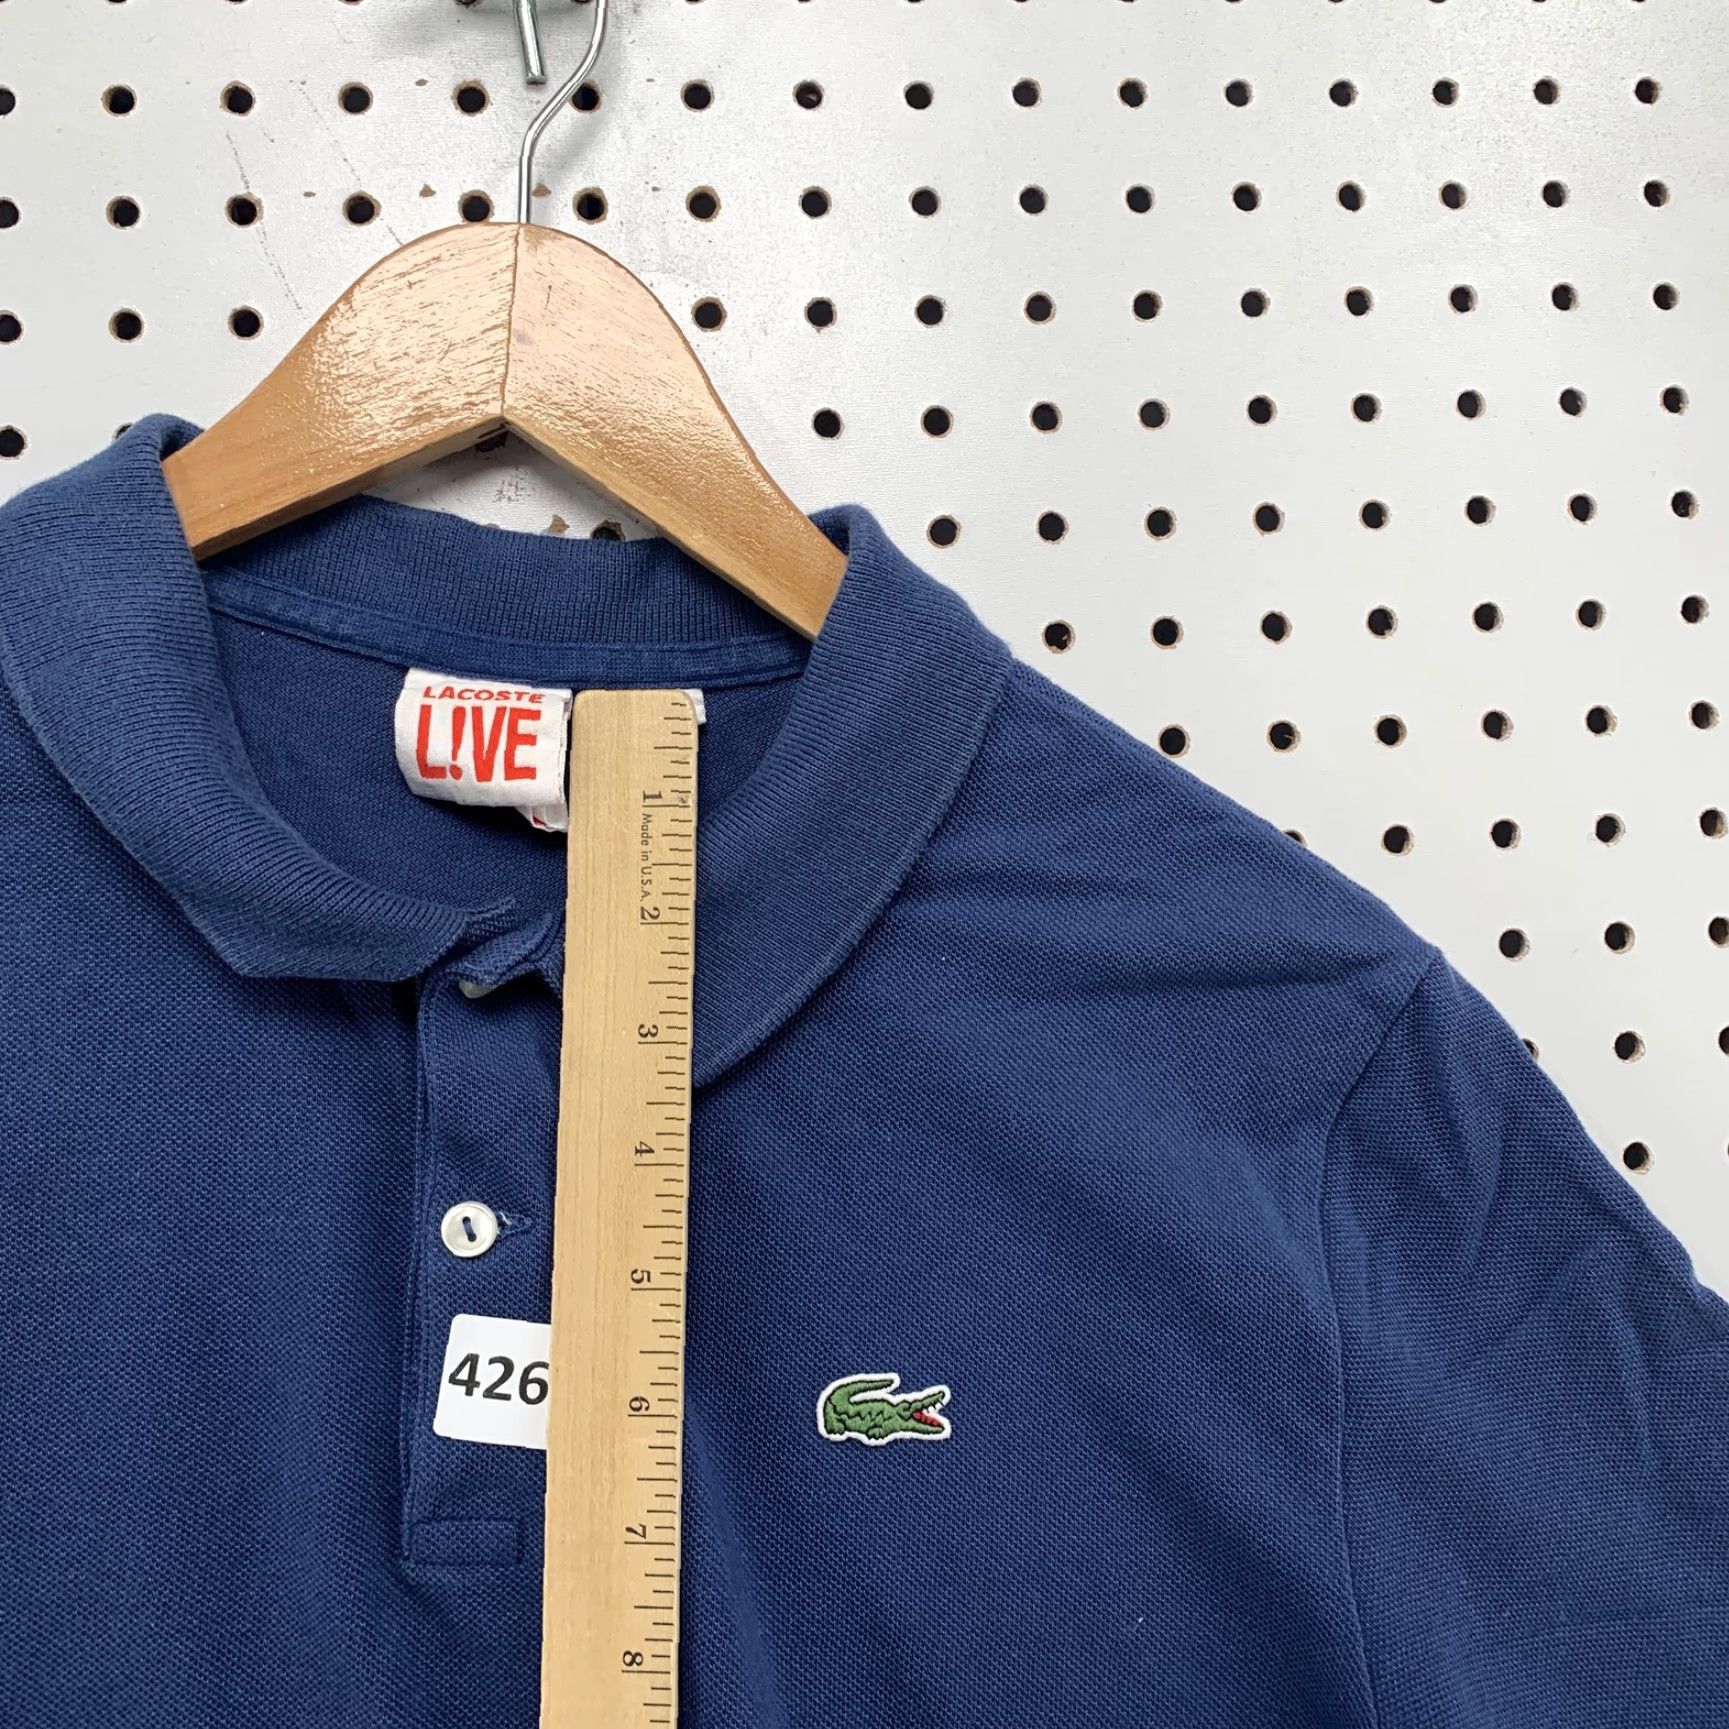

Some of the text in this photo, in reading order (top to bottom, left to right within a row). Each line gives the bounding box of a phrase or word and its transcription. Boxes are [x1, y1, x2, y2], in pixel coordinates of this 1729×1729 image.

[423, 686, 545, 704] LACOSTE
[642, 790, 662, 803] 1
[640, 813, 653, 902] Made in U.S.A.
[640, 906, 660, 921] 2
[638, 1023, 658, 1038] 3
[634, 1141, 655, 1157] 4
[631, 1268, 650, 1284] 5
[448, 1352, 549, 1405] 426
[628, 1396, 650, 1412] 6
[625, 1524, 647, 1539] 7
[622, 1651, 643, 1666] 8
